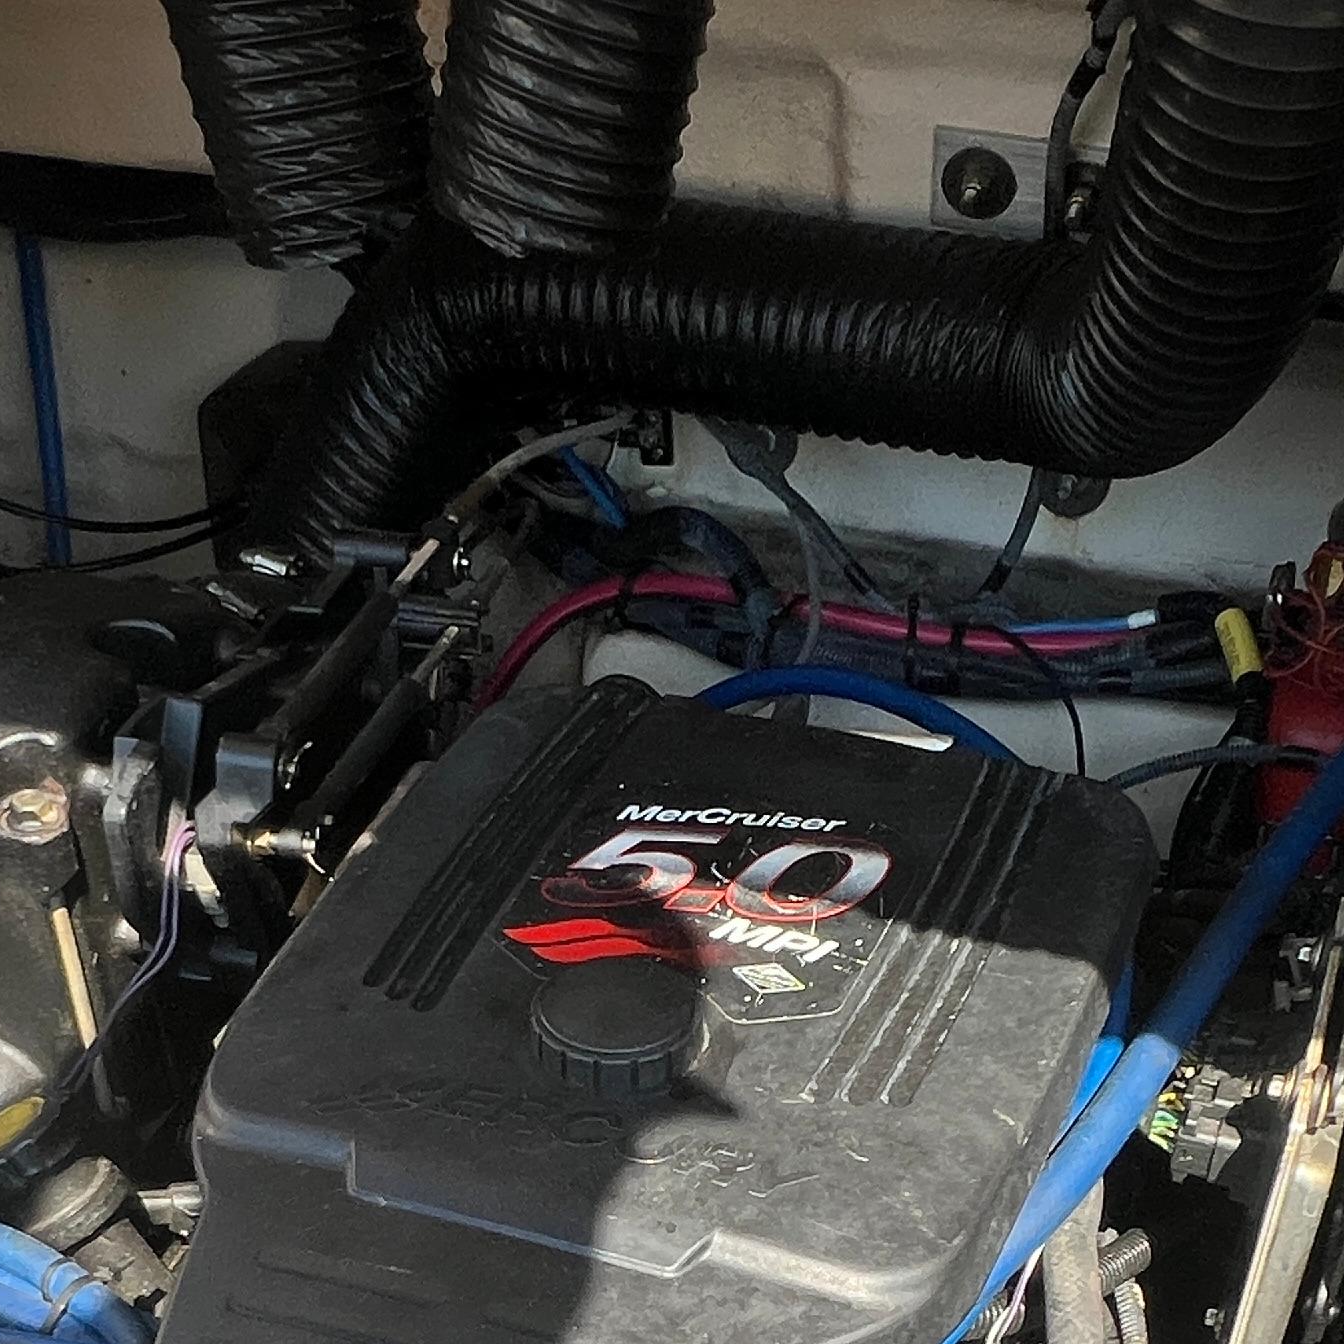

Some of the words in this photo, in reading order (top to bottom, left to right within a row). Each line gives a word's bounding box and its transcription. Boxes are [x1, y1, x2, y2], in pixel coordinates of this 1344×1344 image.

[617, 803, 847, 833] MerCruiser
[540, 826, 893, 923] 5.0
[709, 916, 840, 964] MPI
